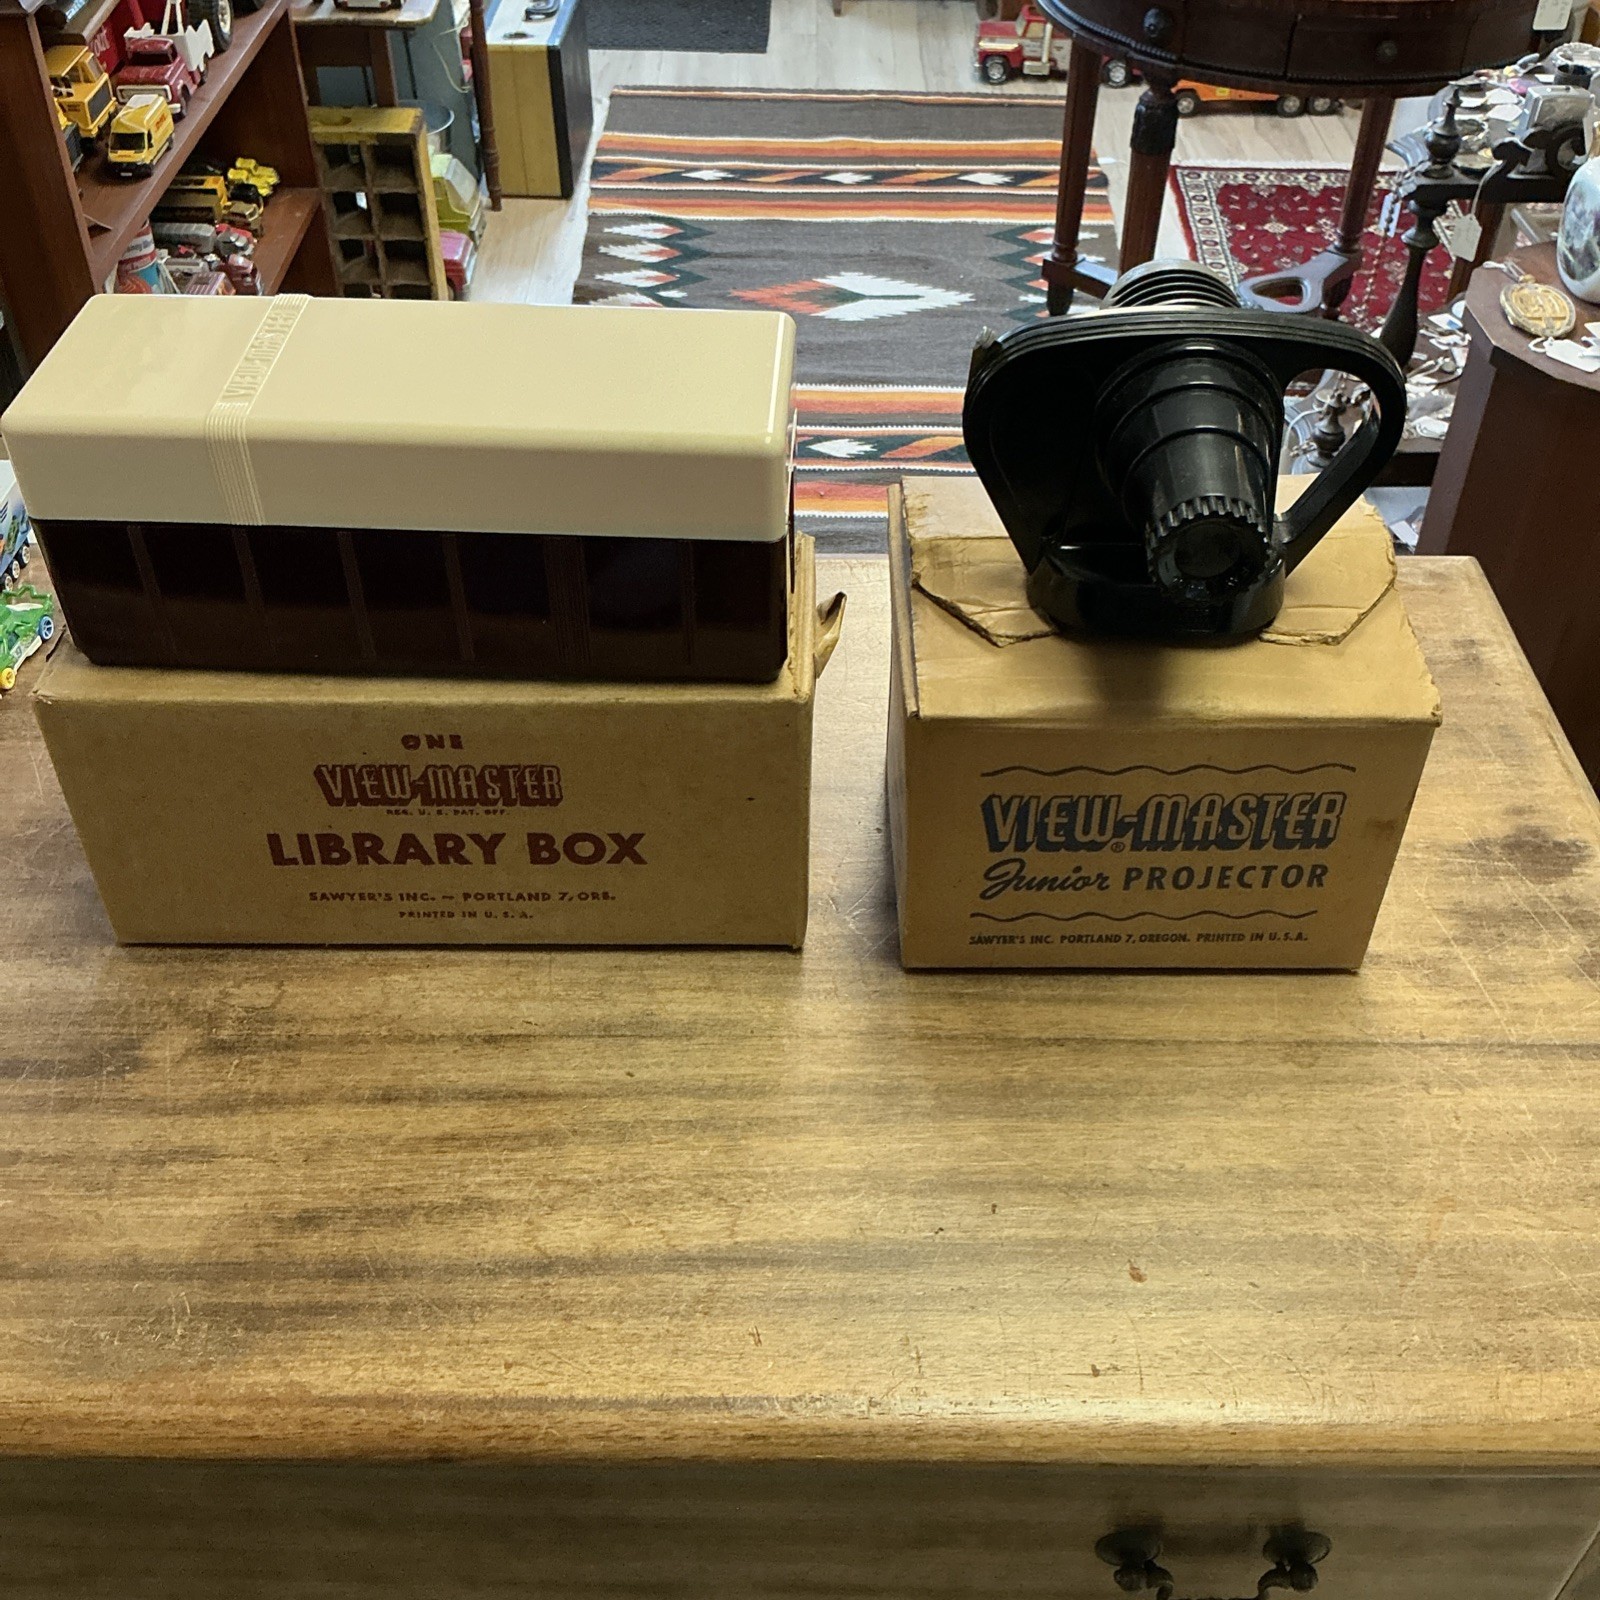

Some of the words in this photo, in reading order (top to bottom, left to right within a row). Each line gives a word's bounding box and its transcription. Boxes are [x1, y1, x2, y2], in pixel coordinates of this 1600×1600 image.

[401, 734, 464, 750] ONE
[313, 764, 563, 807] VIEW-MASTER
[979, 791, 1348, 853] VIEW-MASTER
[266, 832, 507, 867] LIBRARY
[526, 832, 648, 866] BOX
[979, 858, 1110, 900] Junior
[1122, 863, 1329, 892] PROJECTOR
[309, 891, 394, 902] SAWYER'S
[398, 891, 436, 902] INC.
[462, 891, 551, 902] PORTLAND
[399, 910, 456, 919] PRINTED
[461, 910, 478, 919] IN
[968, 934, 1025, 946] SAWYER'S
[1029, 934, 1054, 945] INC.
[1060, 933, 1122, 944] PORTLAND
[1139, 933, 1191, 944] OREGON.
[1196, 932, 1246, 943] PRINTED
[1250, 932, 1264, 942] IN
